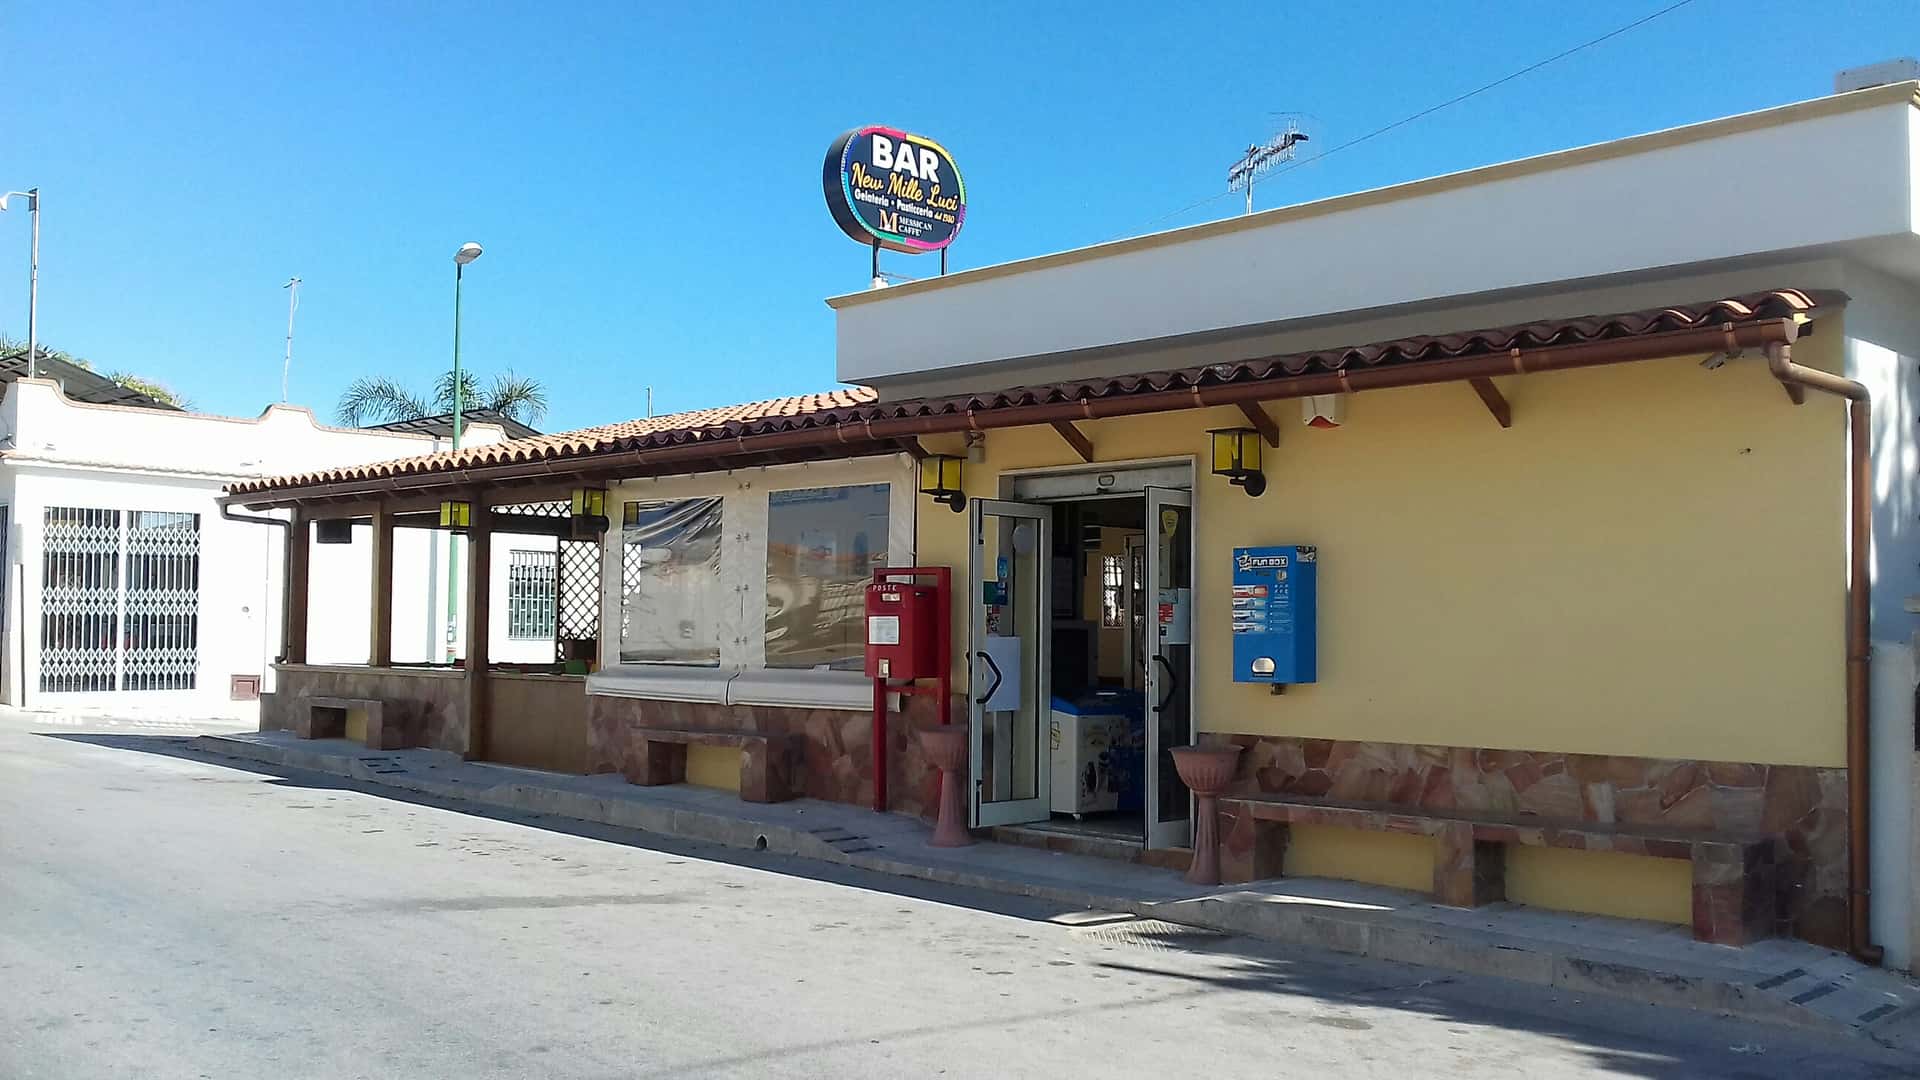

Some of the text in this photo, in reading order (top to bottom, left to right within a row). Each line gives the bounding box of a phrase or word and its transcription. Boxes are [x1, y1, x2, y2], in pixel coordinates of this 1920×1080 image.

[872, 134, 939, 183] BAR
[852, 162, 958, 211] New Mille Luci
[854, 188, 889, 207] Gelateria
[896, 199, 934, 218] Pasticceria
[1269, 558, 1286, 566] BOX
